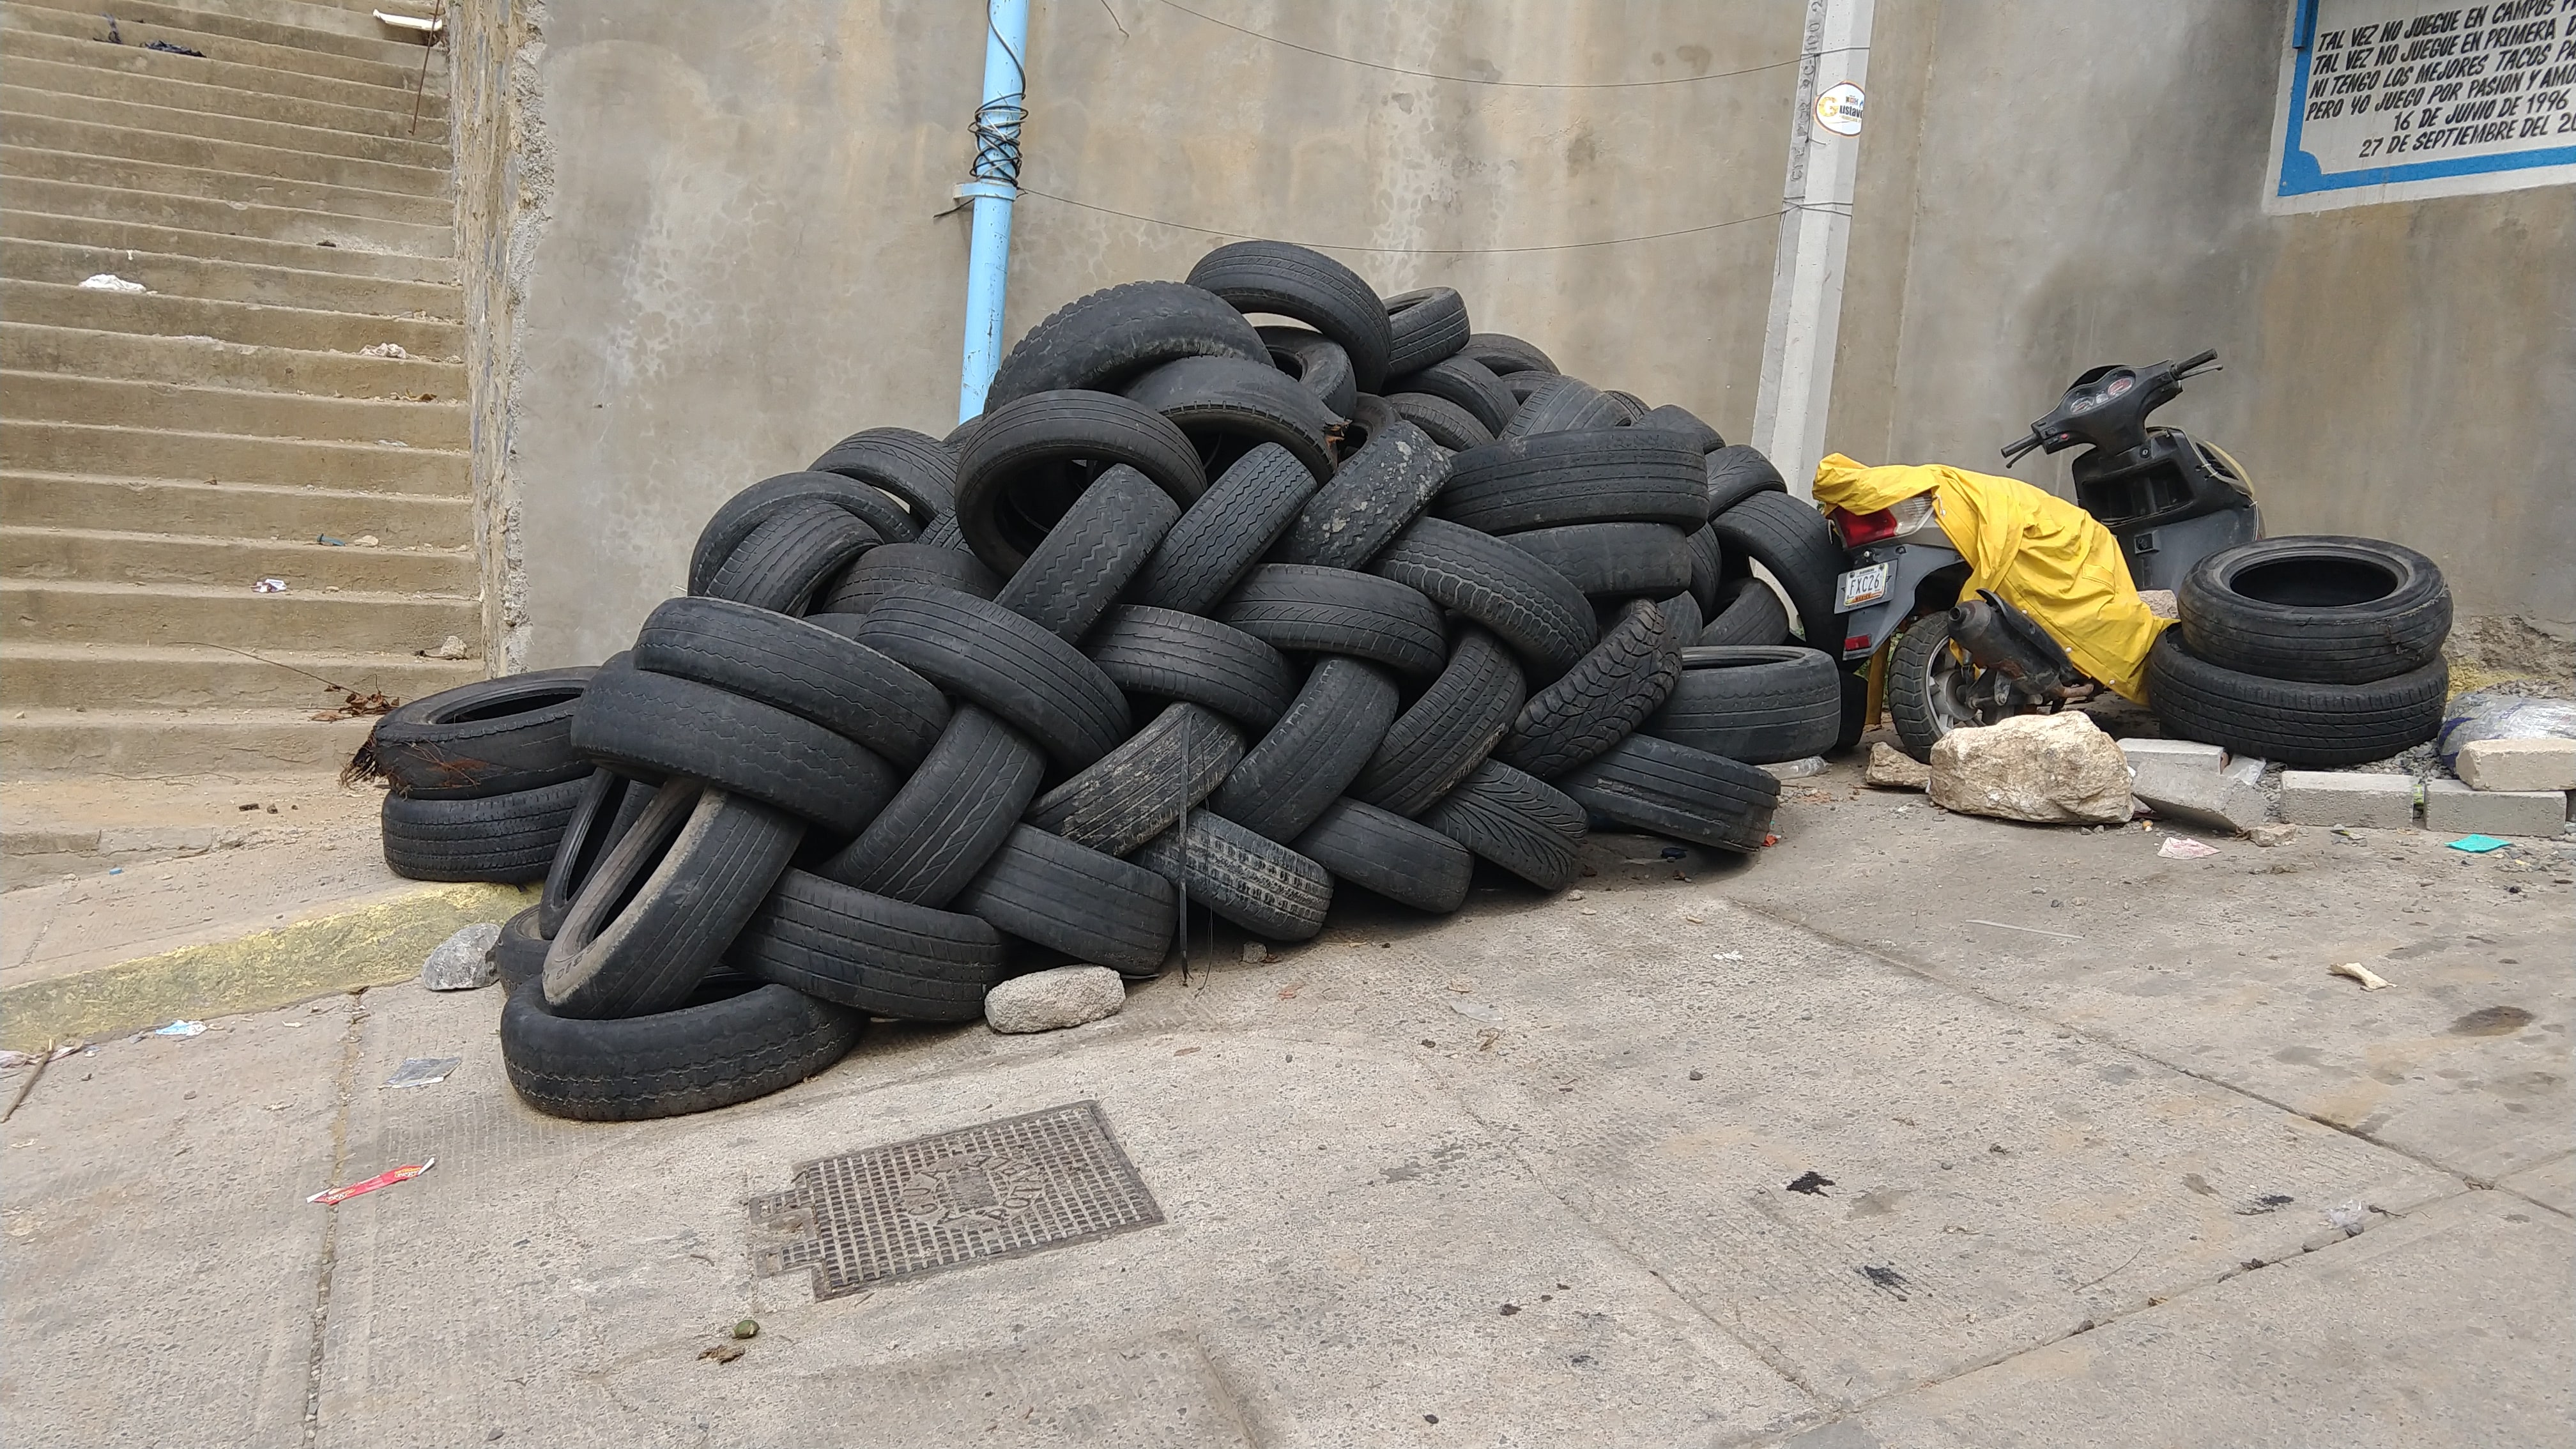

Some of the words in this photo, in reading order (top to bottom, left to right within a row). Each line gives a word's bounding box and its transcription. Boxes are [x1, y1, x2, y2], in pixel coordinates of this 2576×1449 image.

[2313, 52, 2340, 75] TAL
[2345, 47, 2375, 71] VEZ
[2374, 43, 2399, 66] NO
[2400, 34, 2461, 62] JUEGUE
[2460, 30, 2484, 54] EN
[2483, 17, 2556, 50] PRIMERA
[2318, 30, 2346, 52] TAL
[2351, 24, 2379, 47] VEZ
[2379, 20, 2404, 43] NO
[2404, 10, 2462, 38] JUEGUE
[2464, 4, 2489, 29] EN
[2492, 0, 2555, 24] CAMPOS
[2305, 98, 2345, 121] PERO
[2350, 94, 2372, 115] YO
[2374, 87, 2426, 112] JUEGO
[2426, 82, 2464, 105] POR
[2467, 71, 2526, 99] PASION
[2526, 68, 2543, 91] Y
[2309, 77, 2329, 99] NI
[2330, 70, 2380, 96] TENGO
[2382, 66, 2414, 88] LOS
[2414, 54, 2489, 84] MEJORES
[2496, 43, 2553, 72] TACOS
[2358, 137, 2384, 158] 27
[2386, 134, 2411, 154] DE
[2412, 119, 2519, 151] SEPTIEMBRE
[2519, 114, 2551, 138] DEL
[2394, 110, 2415, 132] 16
[2418, 107, 2443, 129] DE
[2445, 98, 2497, 125] JUNIO
[2497, 95, 2524, 118] DE
[2527, 88, 2572, 114] 1996
[1850, 573, 1880, 595] FXC26
